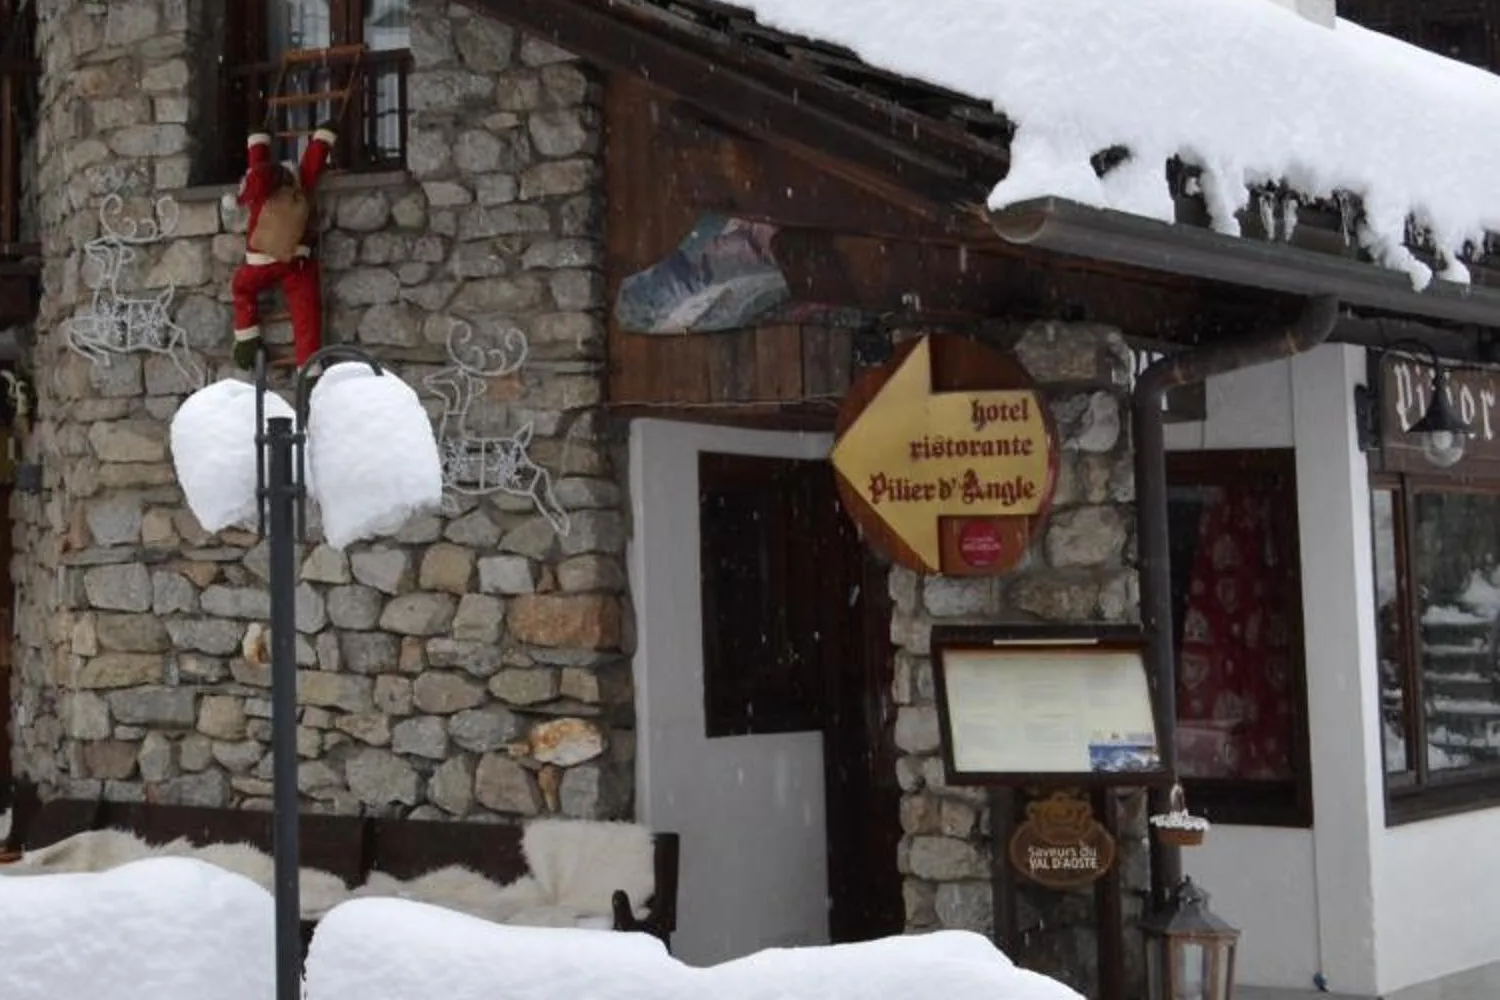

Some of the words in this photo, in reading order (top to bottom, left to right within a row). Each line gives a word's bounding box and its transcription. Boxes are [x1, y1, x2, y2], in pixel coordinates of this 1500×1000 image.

[909, 434, 1034, 462] ristorante
[868, 471, 936, 505] Pilier
[938, 467, 1036, 506] d'Angle
[1029, 856, 1050, 870] VAL
